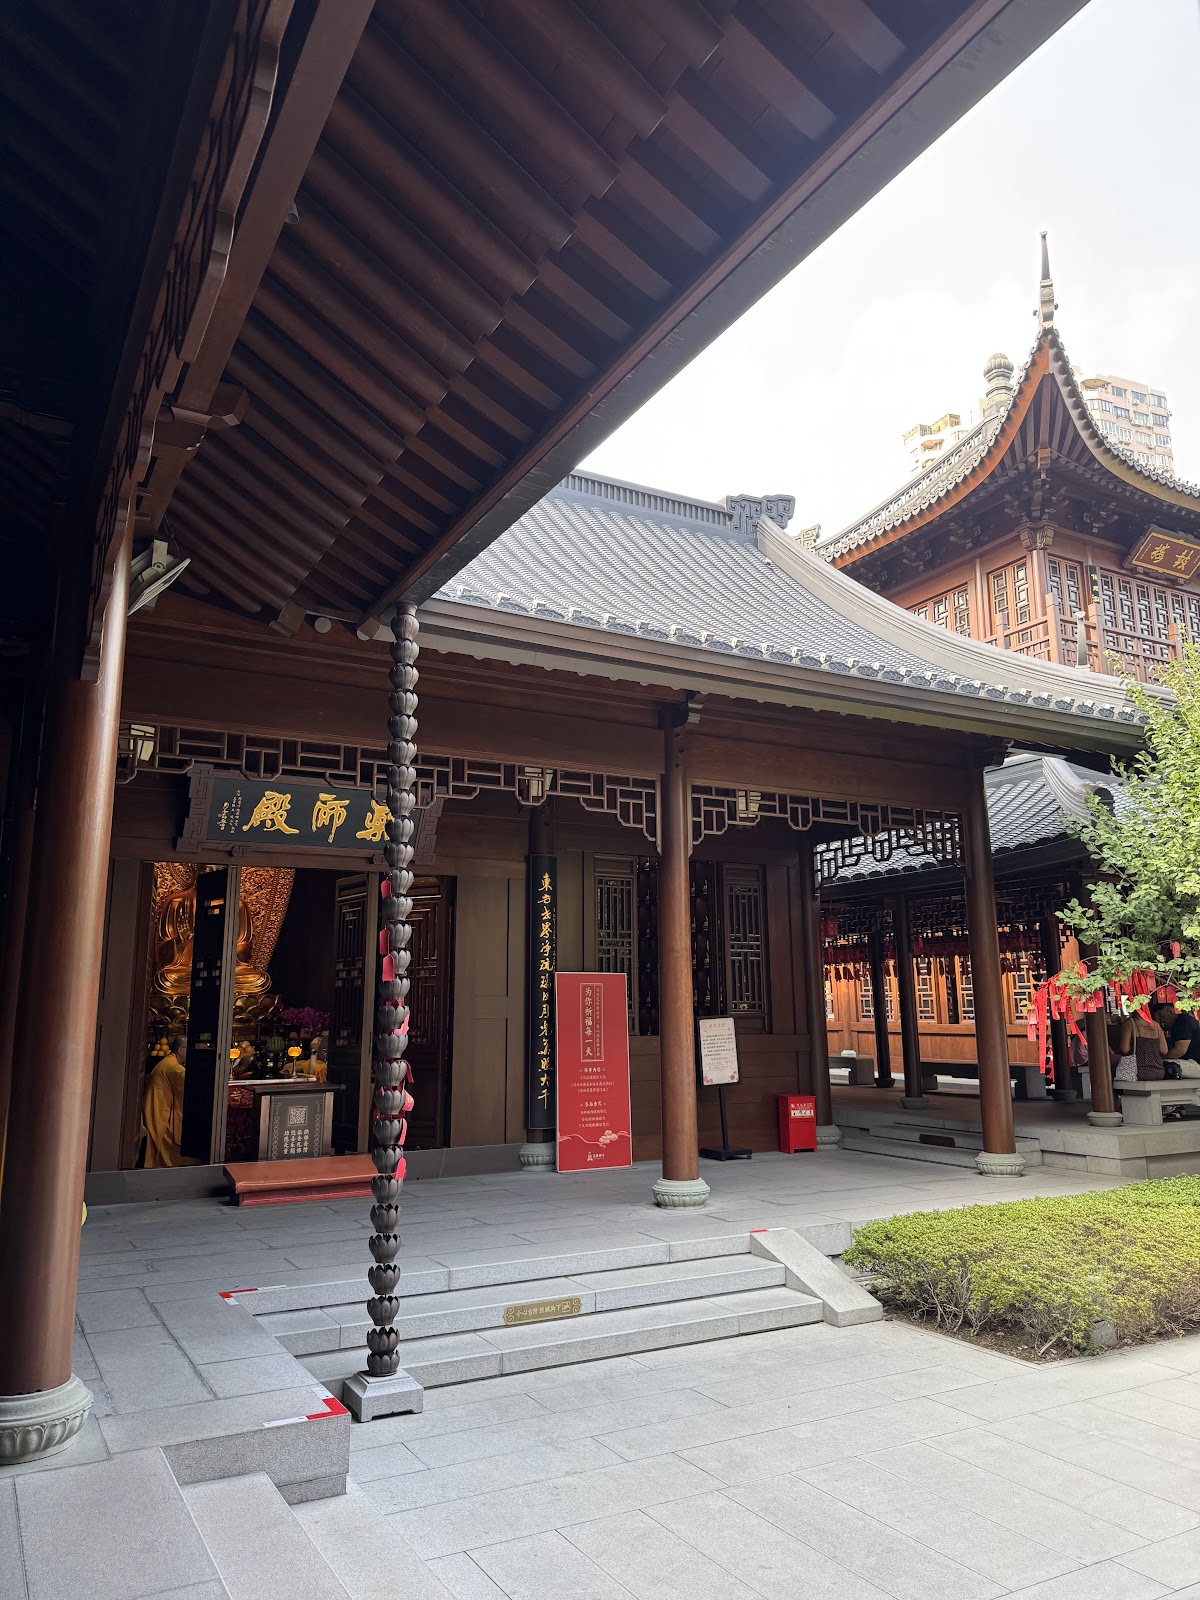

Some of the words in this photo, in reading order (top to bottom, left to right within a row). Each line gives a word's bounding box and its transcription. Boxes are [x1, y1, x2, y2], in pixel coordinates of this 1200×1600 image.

[584, 986, 593, 1057] 为你祈福每一天
